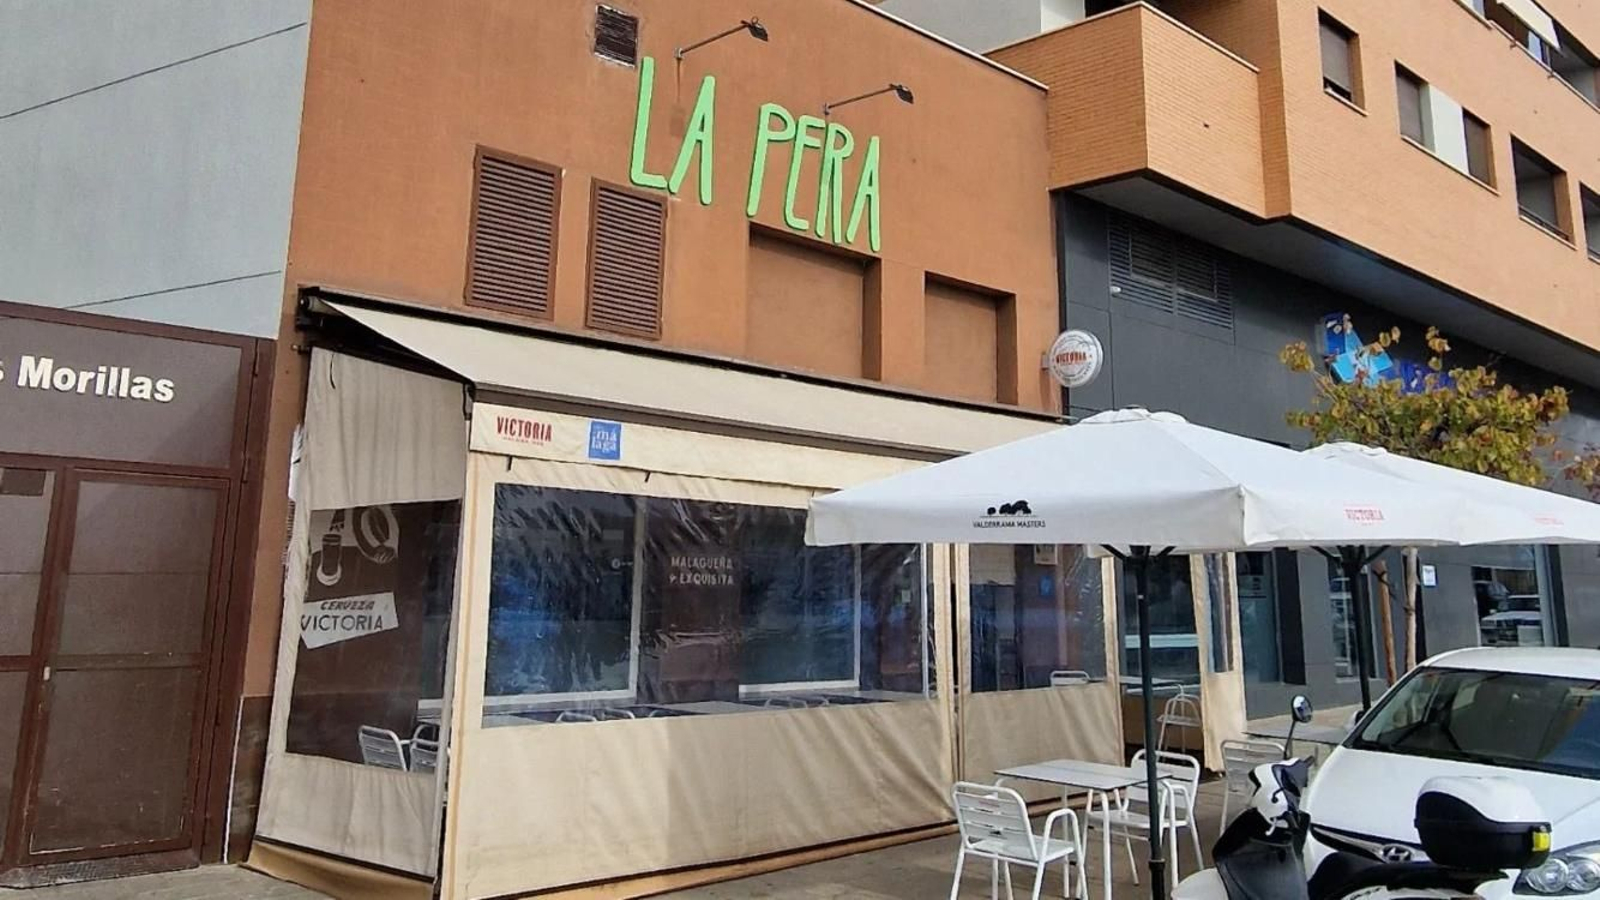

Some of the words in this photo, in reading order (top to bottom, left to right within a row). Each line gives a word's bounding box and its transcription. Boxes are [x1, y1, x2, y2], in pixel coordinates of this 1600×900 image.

[631, 56, 716, 205] LA
[747, 102, 881, 252] PERA
[17, 355, 175, 403] Morillas
[496, 416, 553, 442] VICTORIA
[1016, 520, 1046, 528] MASTERS
[671, 556, 733, 570] MALAGUEÑA
[680, 573, 735, 586] EXQUISITA
[320, 601, 375, 611] CERVEZA
[300, 614, 383, 631] VICTORIA
